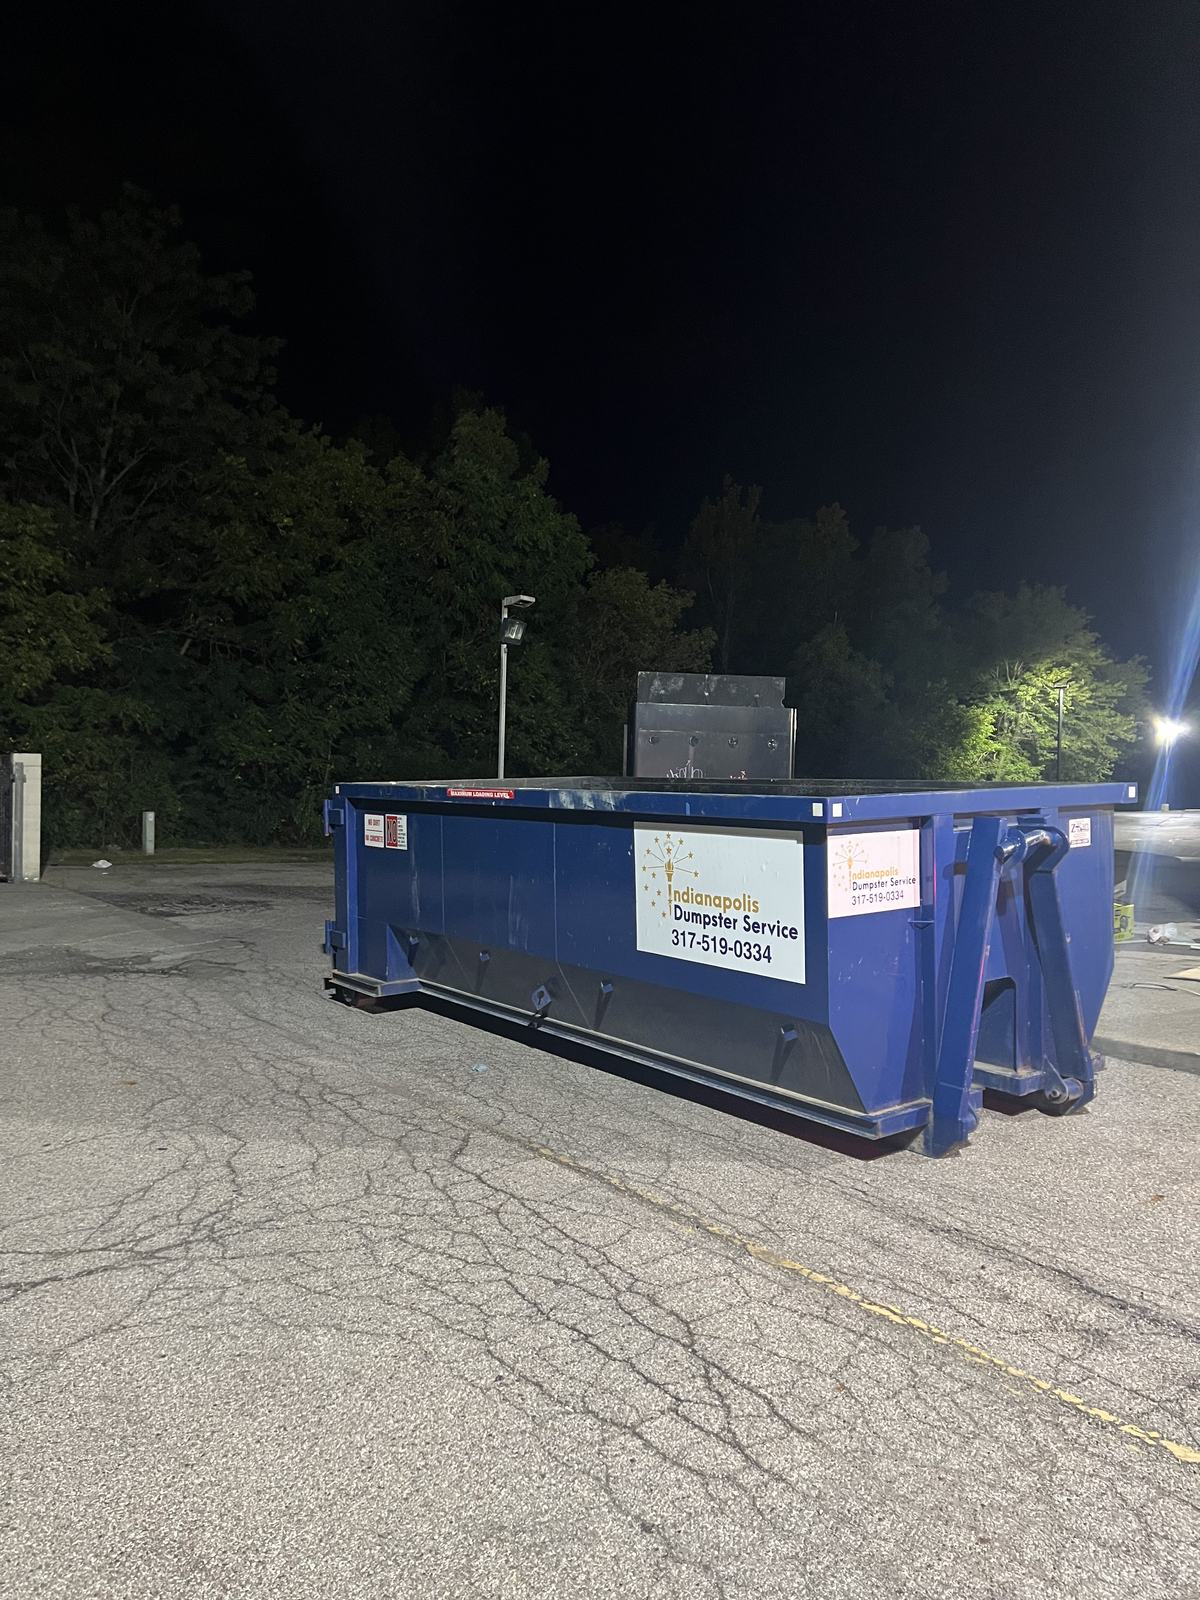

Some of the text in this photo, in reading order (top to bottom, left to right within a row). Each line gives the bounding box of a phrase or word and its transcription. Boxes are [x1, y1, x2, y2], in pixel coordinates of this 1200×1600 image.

[387, 819, 397, 844] NO
[849, 867, 899, 882] Indianapolis
[852, 876, 916, 891] Dumpster Service
[668, 884, 760, 914] Indianapolis
[851, 890, 904, 906] 317-519-0334
[674, 904, 799, 940] Dumpster Service
[671, 929, 772, 964] 317-519-0334
